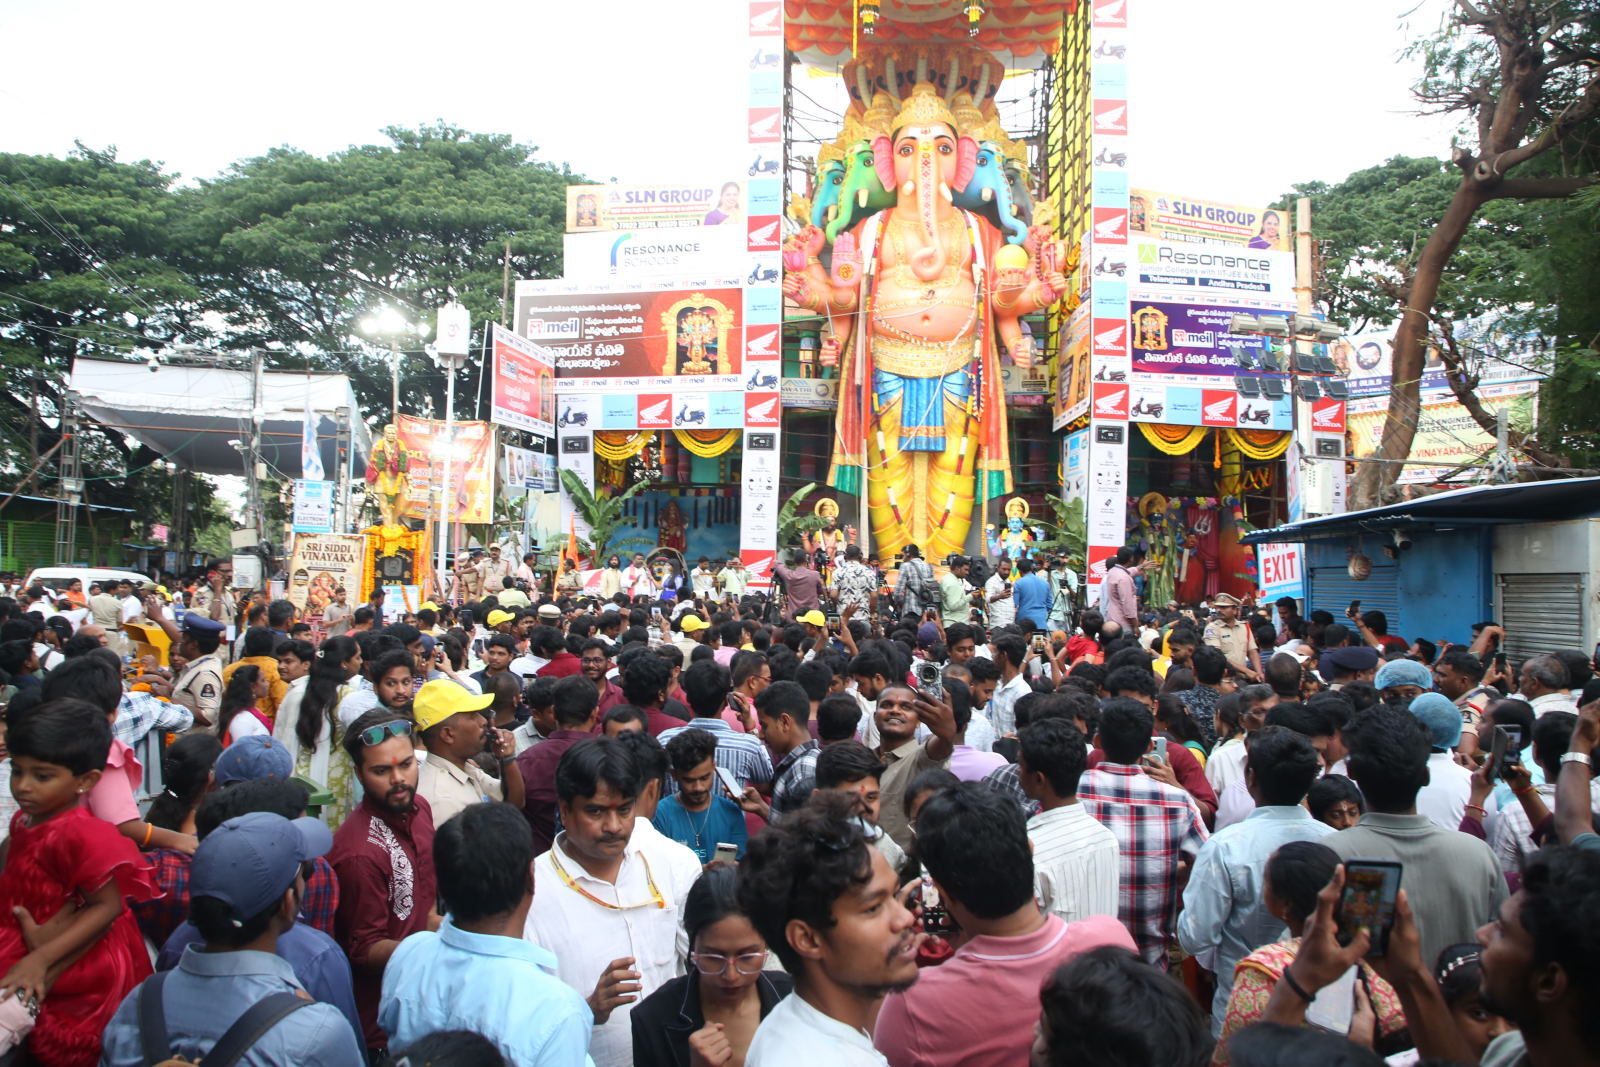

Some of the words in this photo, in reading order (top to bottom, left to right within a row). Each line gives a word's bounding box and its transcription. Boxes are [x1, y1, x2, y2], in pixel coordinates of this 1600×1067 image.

[625, 190, 656, 203] SLN
[659, 188, 714, 203] GROUP
[1173, 201, 1203, 218] SLN
[1205, 207, 1256, 226] GROUP
[624, 242, 701, 256] RESONANCE
[624, 256, 680, 267] SCHOOLS
[1159, 247, 1270, 271] Resonance
[1165, 265, 1198, 275] Colleges
[1148, 274, 1188, 285] Telangana
[1208, 279, 1235, 289] Andhra
[1236, 281, 1266, 291] Pradesh
[547, 319, 578, 333] meil
[1188, 332, 1213, 343] meil
[1204, 415, 1235, 423] HONDA
[1313, 420, 1342, 428] HONDA
[1416, 446, 1463, 458] VINAYAKA
[306, 543, 322, 551] SRI
[324, 543, 351, 553] SIDDI
[301, 552, 355, 563] VINAYAKA
[1264, 551, 1296, 584] EXIT
